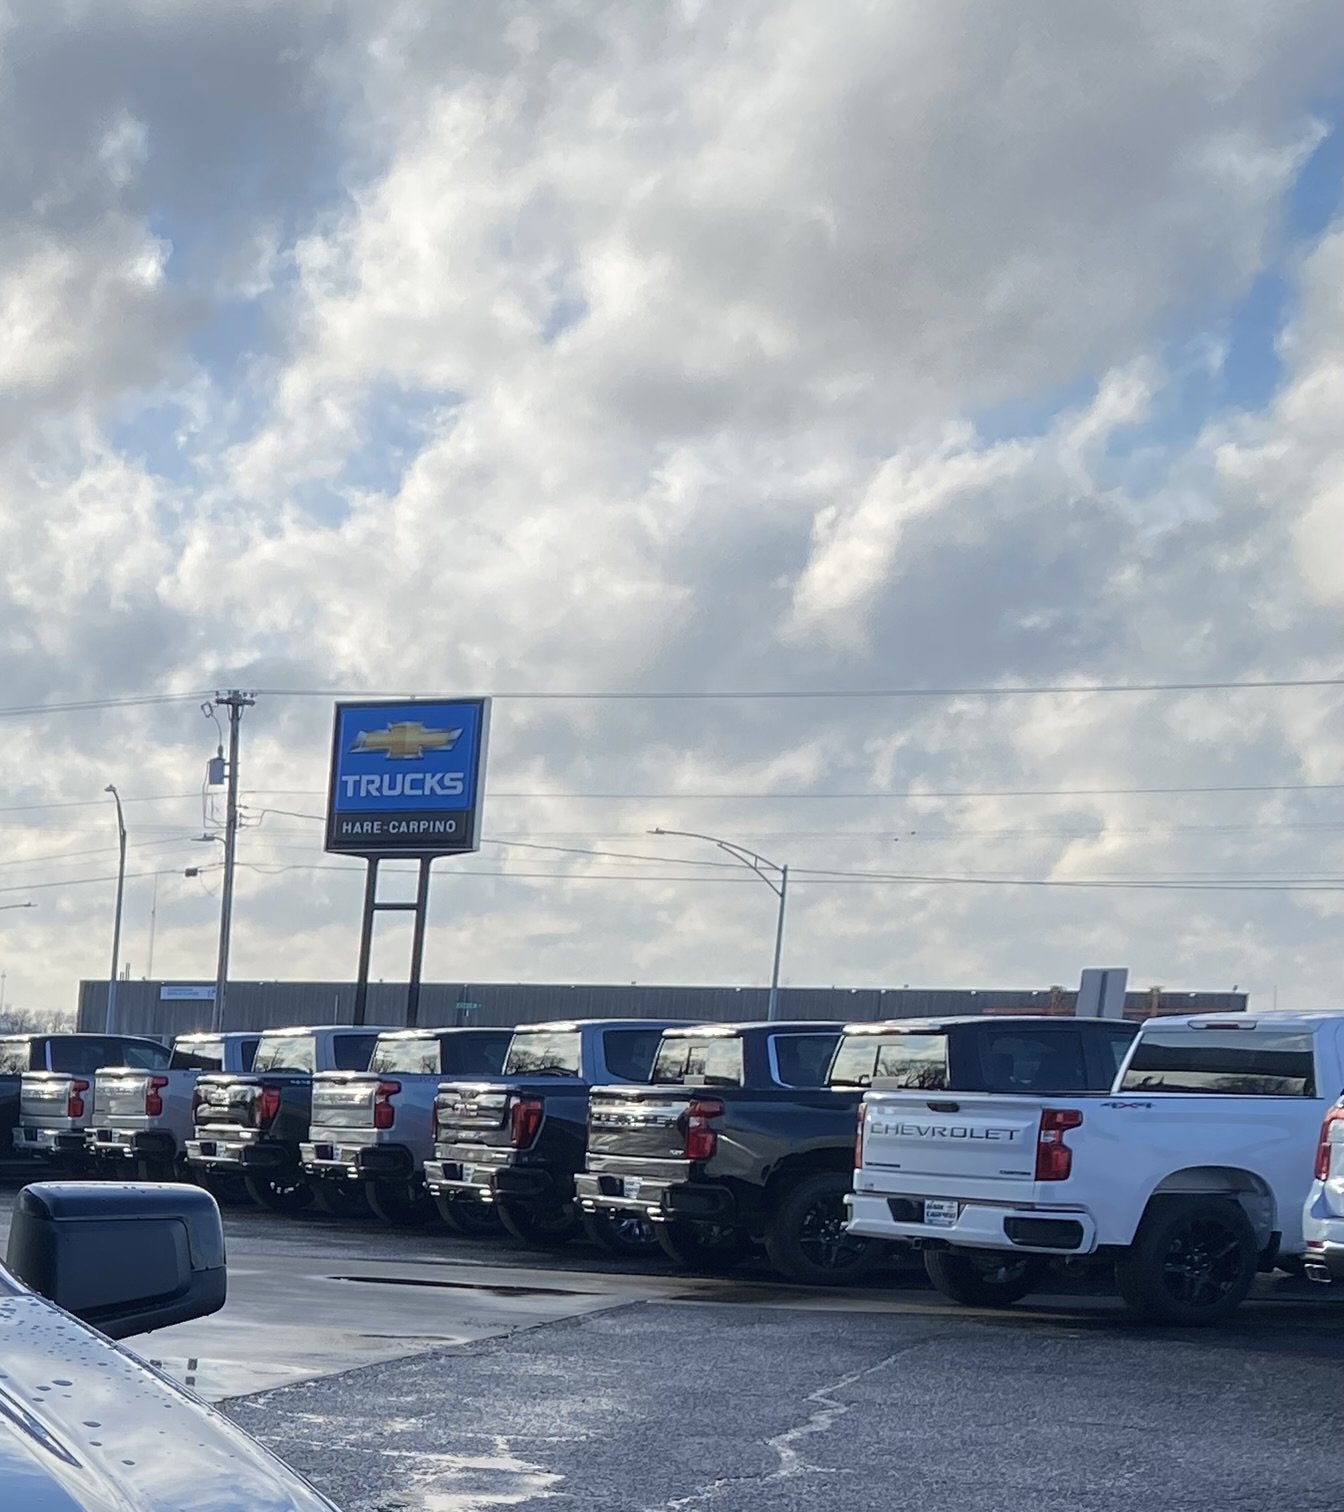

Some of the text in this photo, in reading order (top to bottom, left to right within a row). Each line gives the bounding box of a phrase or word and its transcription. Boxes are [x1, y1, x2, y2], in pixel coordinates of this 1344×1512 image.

[342, 772, 464, 797] TRUCKS
[342, 820, 457, 834] HARE-CARPINO
[869, 1121, 1021, 1141] CHEVROLET
